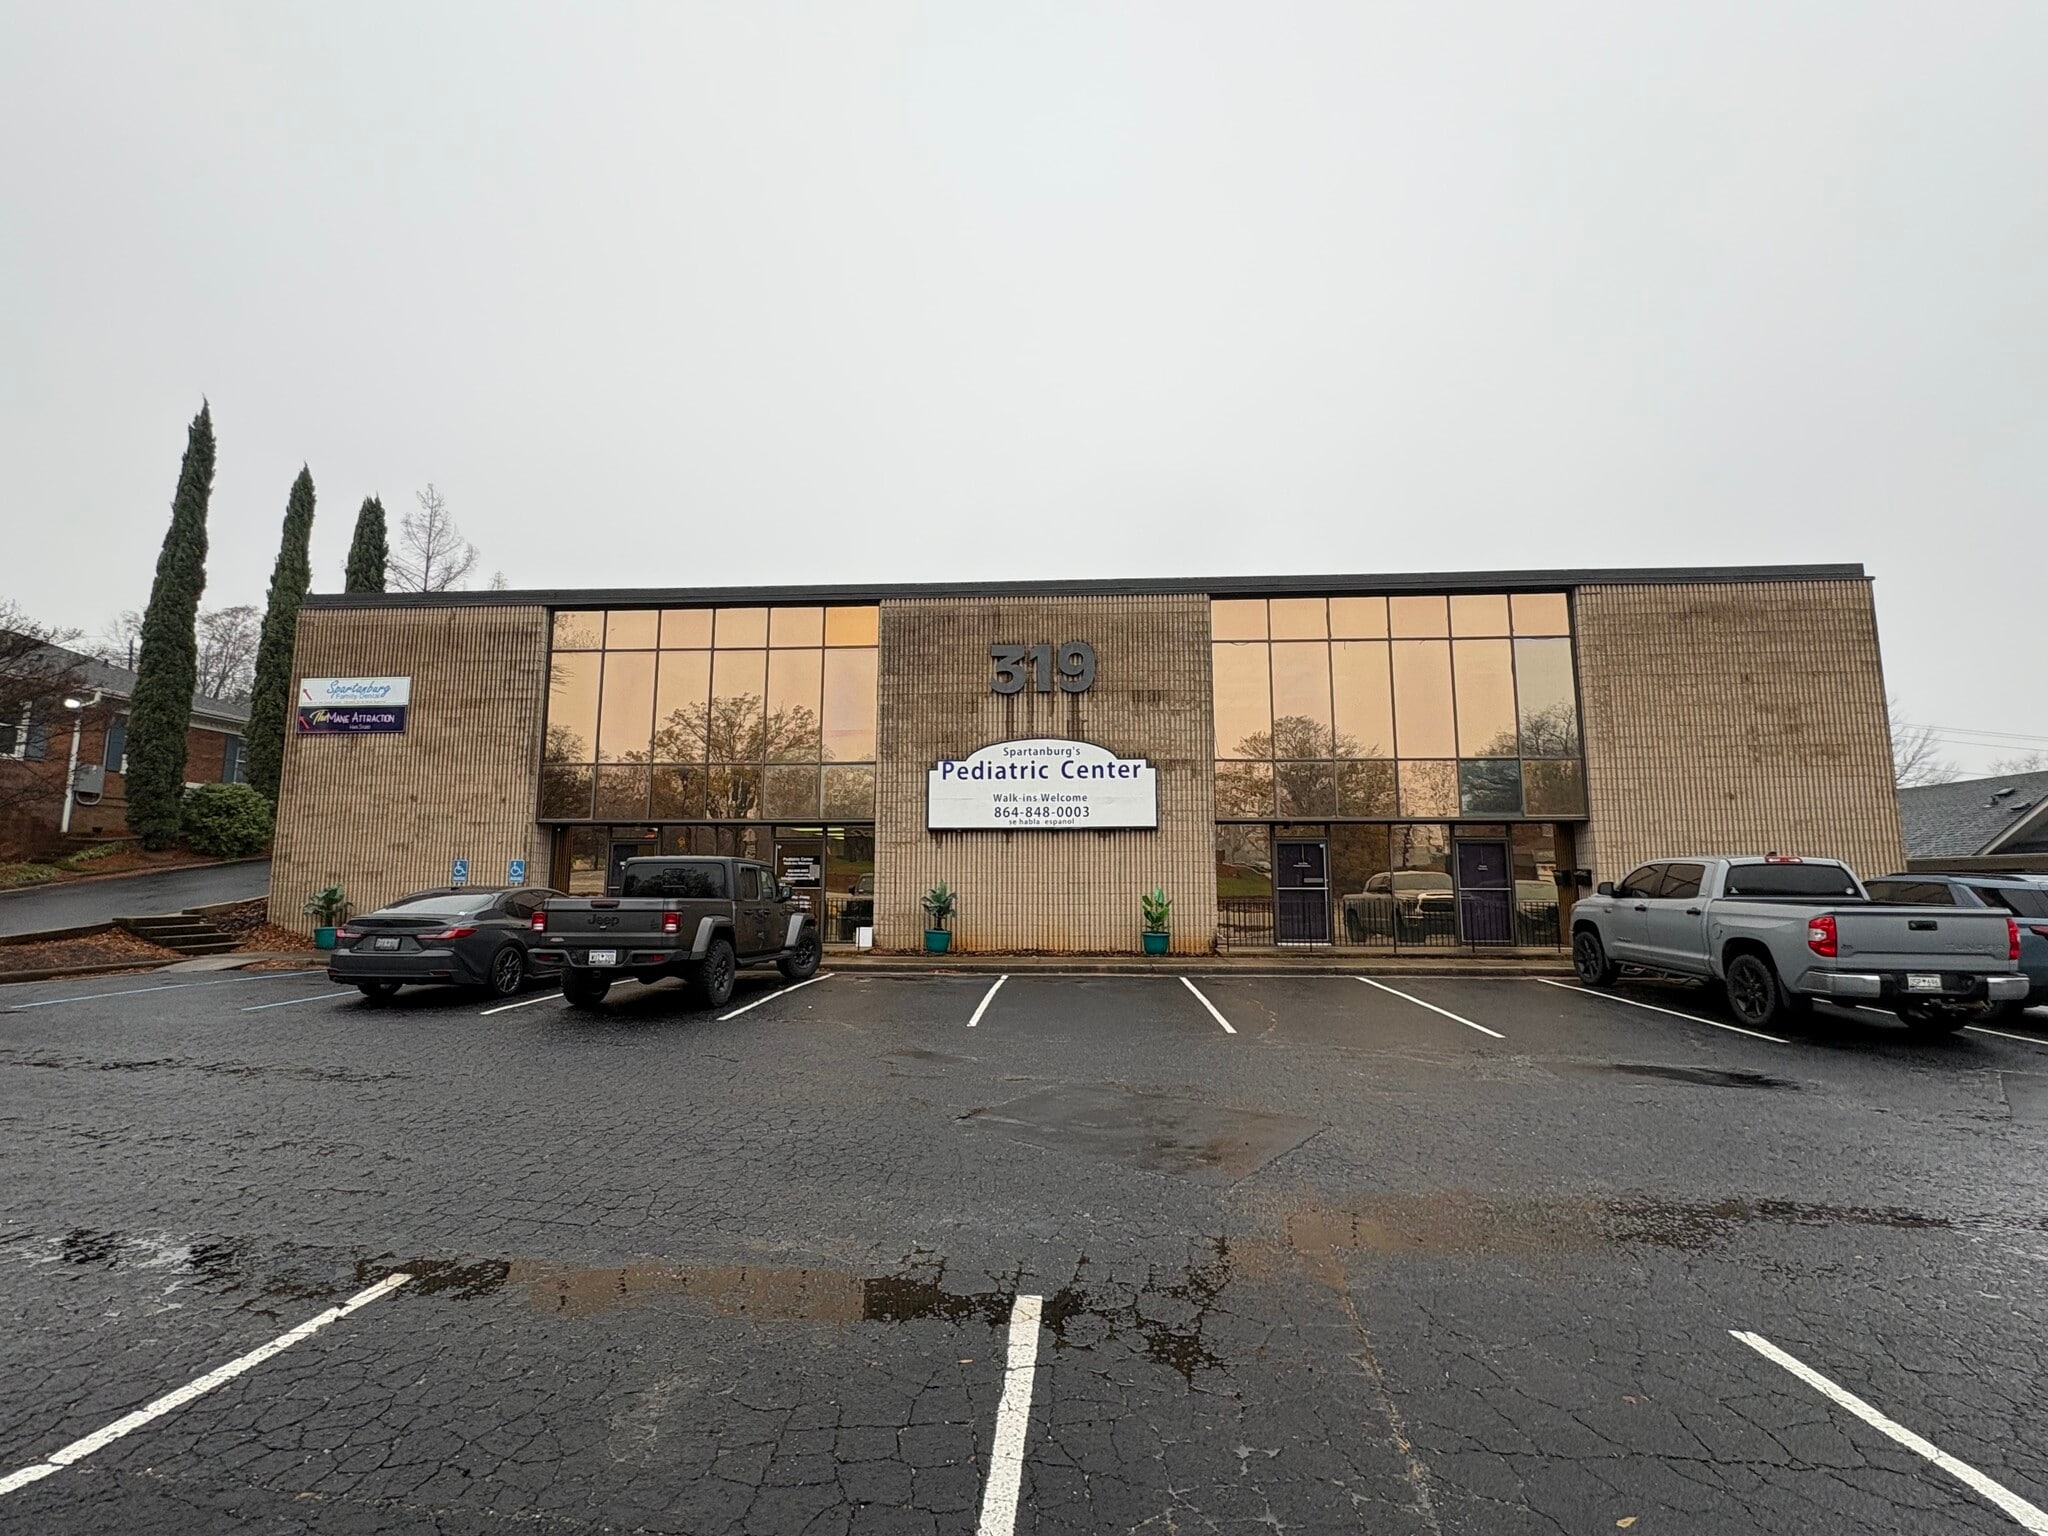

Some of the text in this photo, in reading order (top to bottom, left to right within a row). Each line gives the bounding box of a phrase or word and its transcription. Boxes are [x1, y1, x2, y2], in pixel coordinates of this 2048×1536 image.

[991, 641, 1096, 694] 319
[327, 679, 391, 699] Spartanburg
[309, 709, 329, 725] The
[351, 711, 395, 723] ATTRACTION
[1002, 746, 1081, 758] Spartanburg's
[941, 760, 1142, 780] Pediatric Center
[993, 793, 1088, 803] Walk-ins Welcome
[994, 806, 1090, 818] 864-848-0003
[1019, 818, 1041, 826] habla
[587, 913, 620, 927] Jeep
